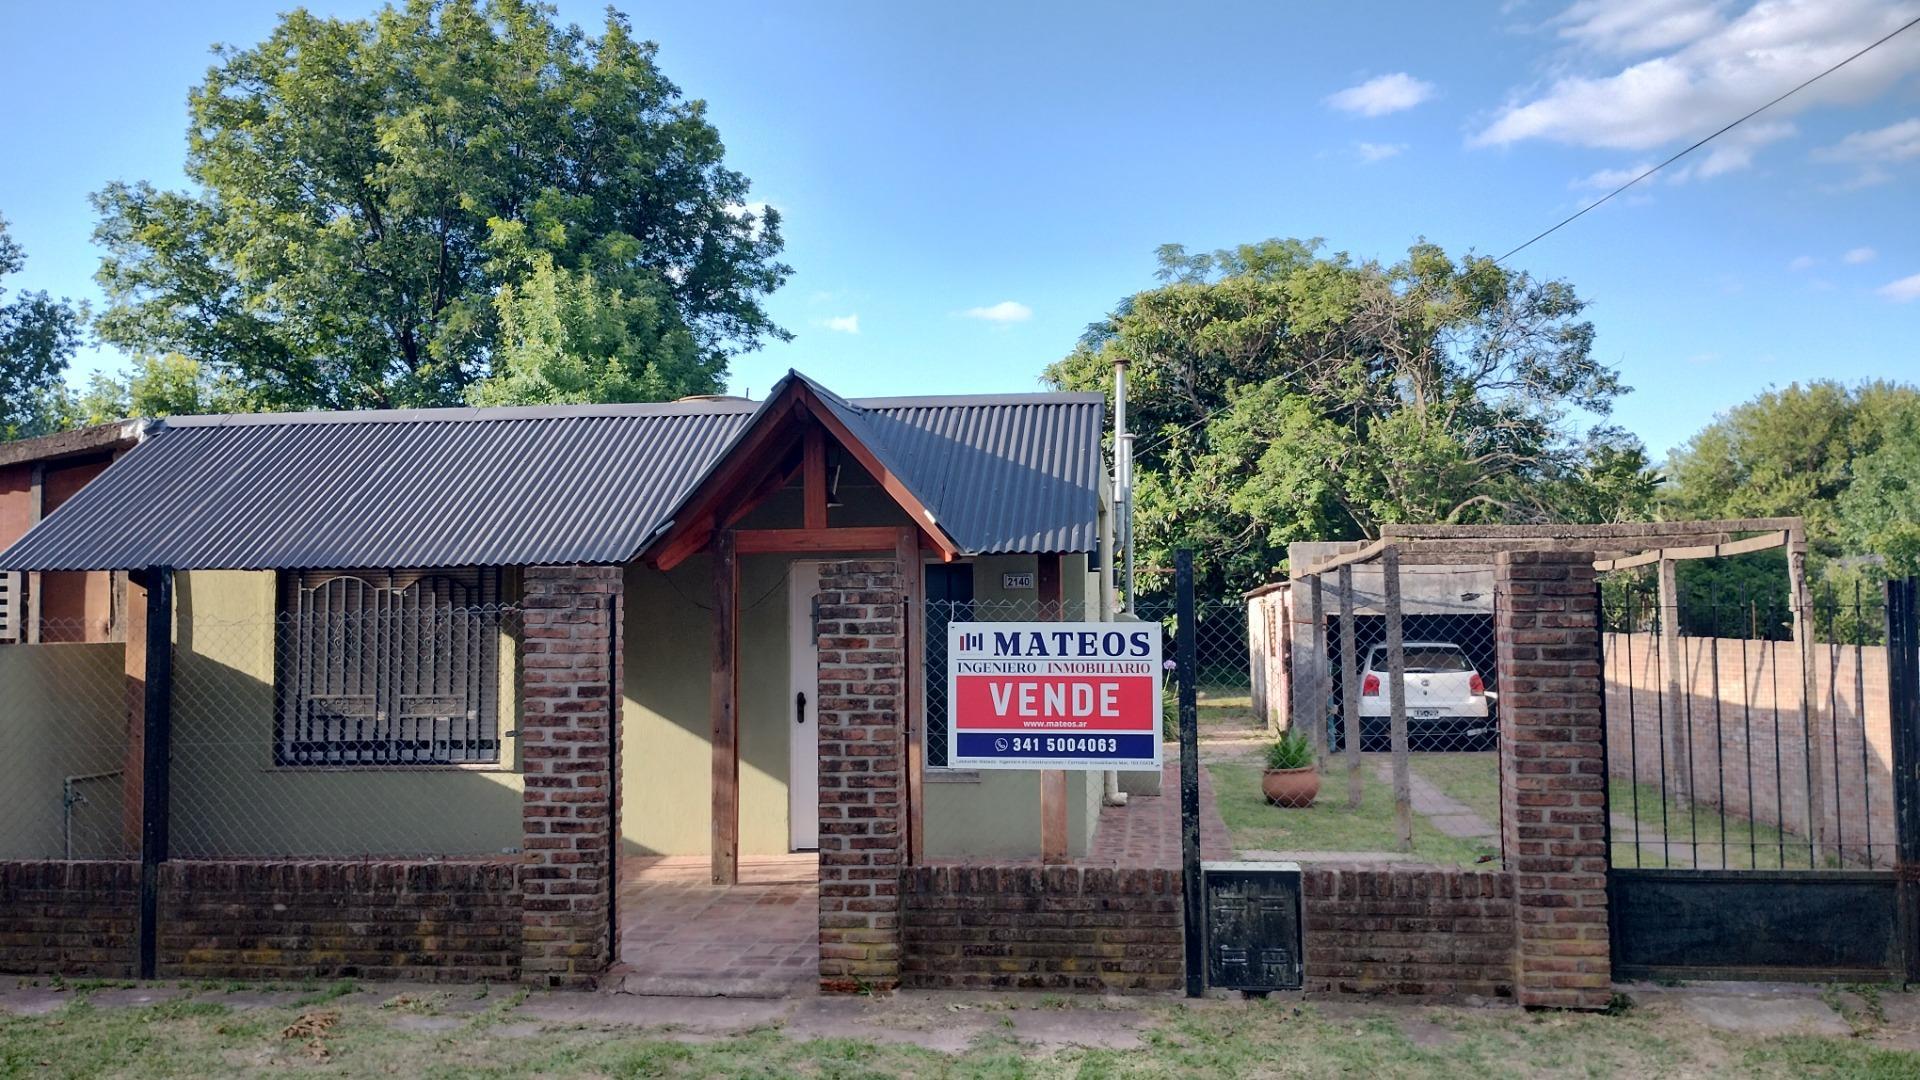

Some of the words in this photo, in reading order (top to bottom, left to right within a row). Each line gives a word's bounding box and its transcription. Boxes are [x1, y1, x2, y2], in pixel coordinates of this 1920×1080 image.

[1007, 577, 1030, 586] 2140
[993, 631, 1151, 657] MATEOS
[957, 662, 1037, 674] INGENIERO
[1047, 662, 1151, 674] INMOBILIARIO
[989, 682, 1120, 717] VENDE
[1023, 720, 1088, 728] www.mateos.ar
[1012, 737, 1039, 752] 341
[1046, 738, 1117, 753] 5004063
